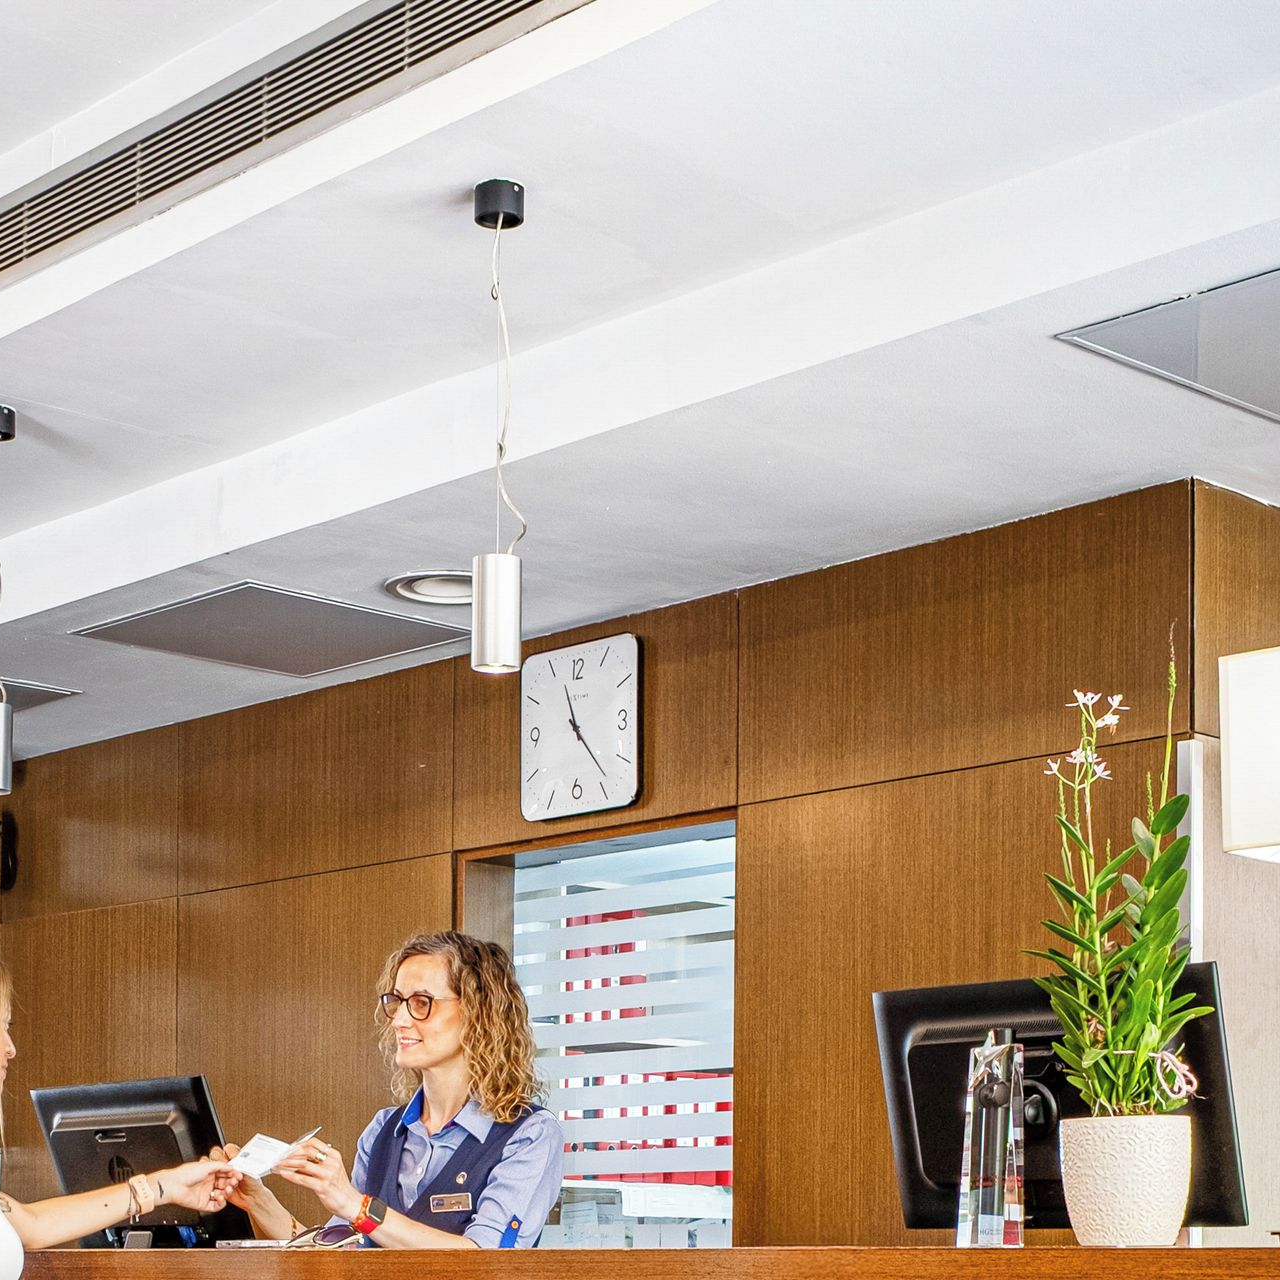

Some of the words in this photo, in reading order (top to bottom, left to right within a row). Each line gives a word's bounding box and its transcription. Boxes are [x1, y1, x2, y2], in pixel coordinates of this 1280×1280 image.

[571, 657, 585, 681] 12
[617, 708, 628, 731] 3
[529, 726, 541, 749] 9
[571, 777, 583, 800] 6
